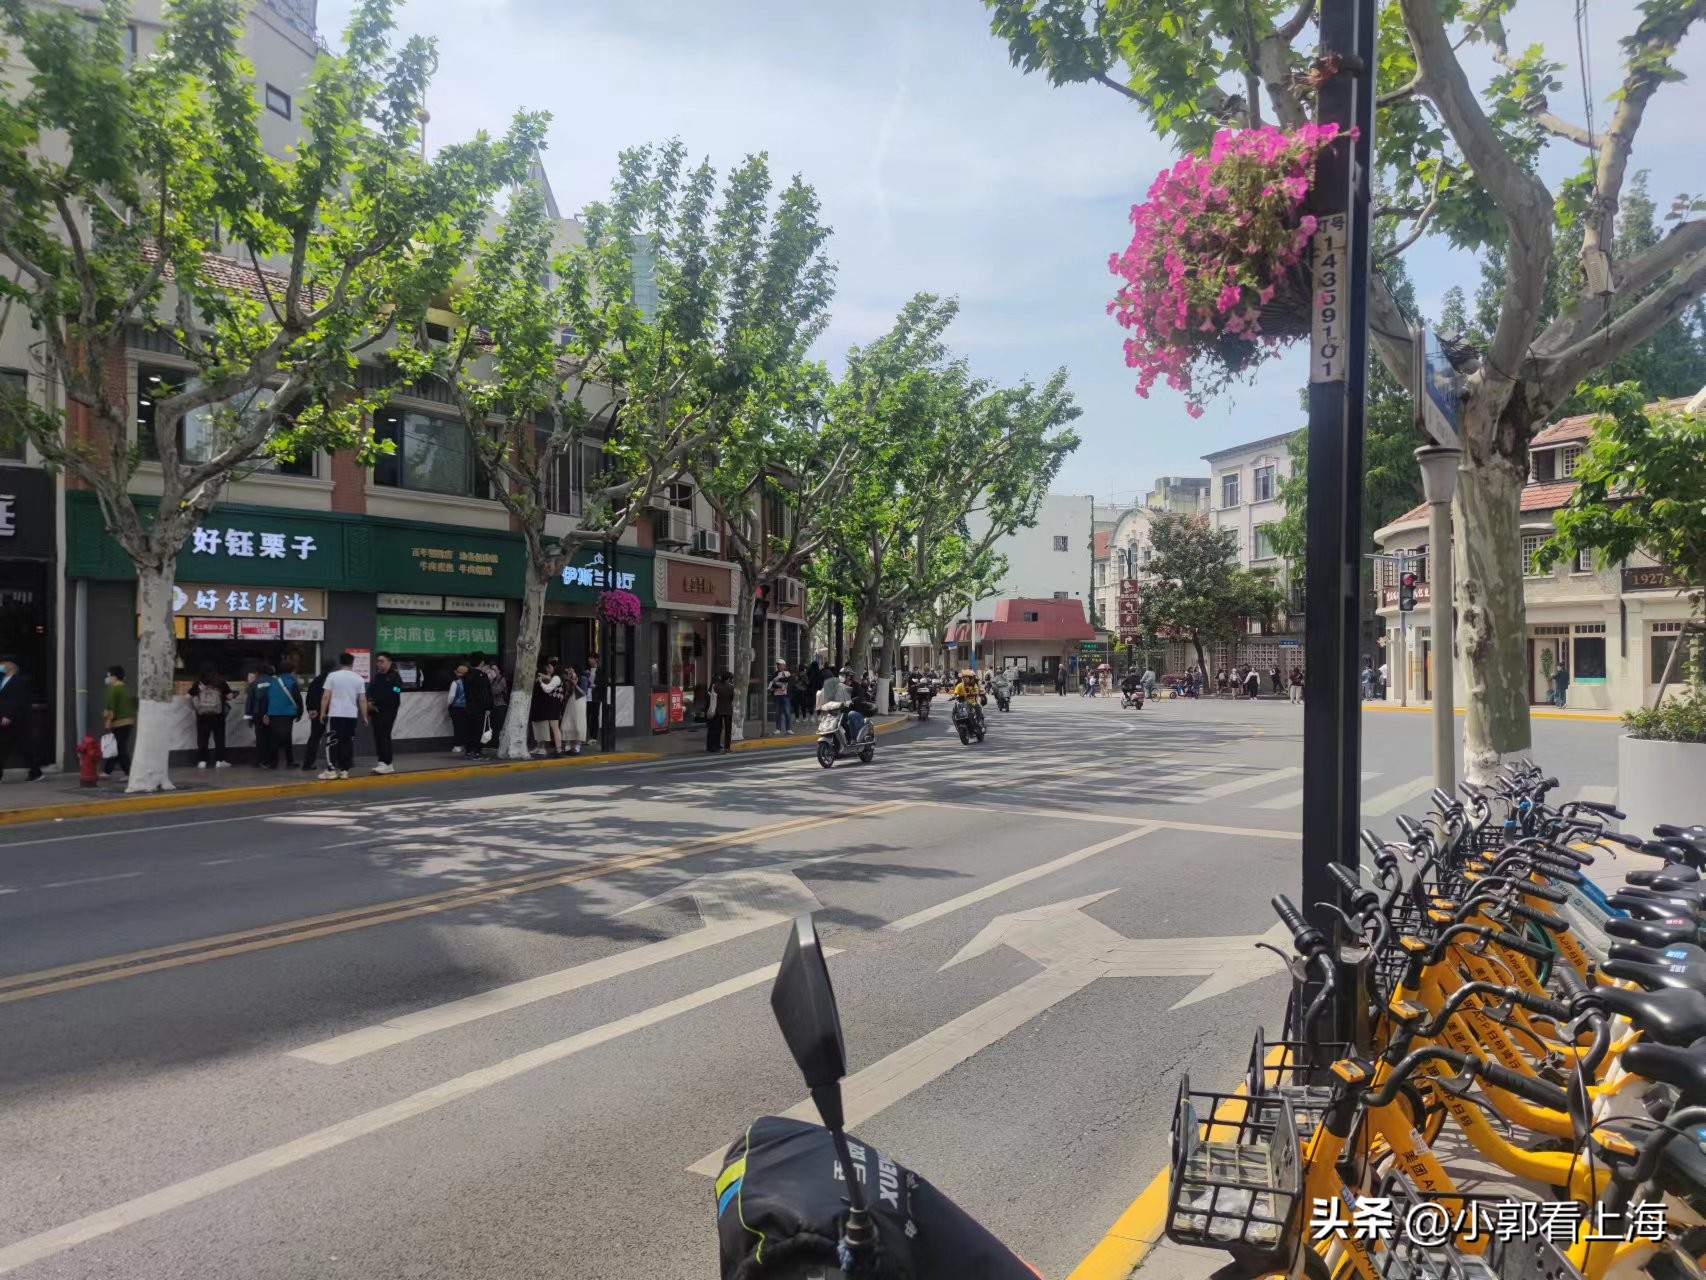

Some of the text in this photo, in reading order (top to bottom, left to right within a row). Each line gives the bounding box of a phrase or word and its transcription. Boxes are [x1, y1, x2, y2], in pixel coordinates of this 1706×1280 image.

[192, 527, 317, 560] 好钰栗子
[1633, 572, 1665, 585] 1927
[378, 625, 436, 643] 牛肉煎包
